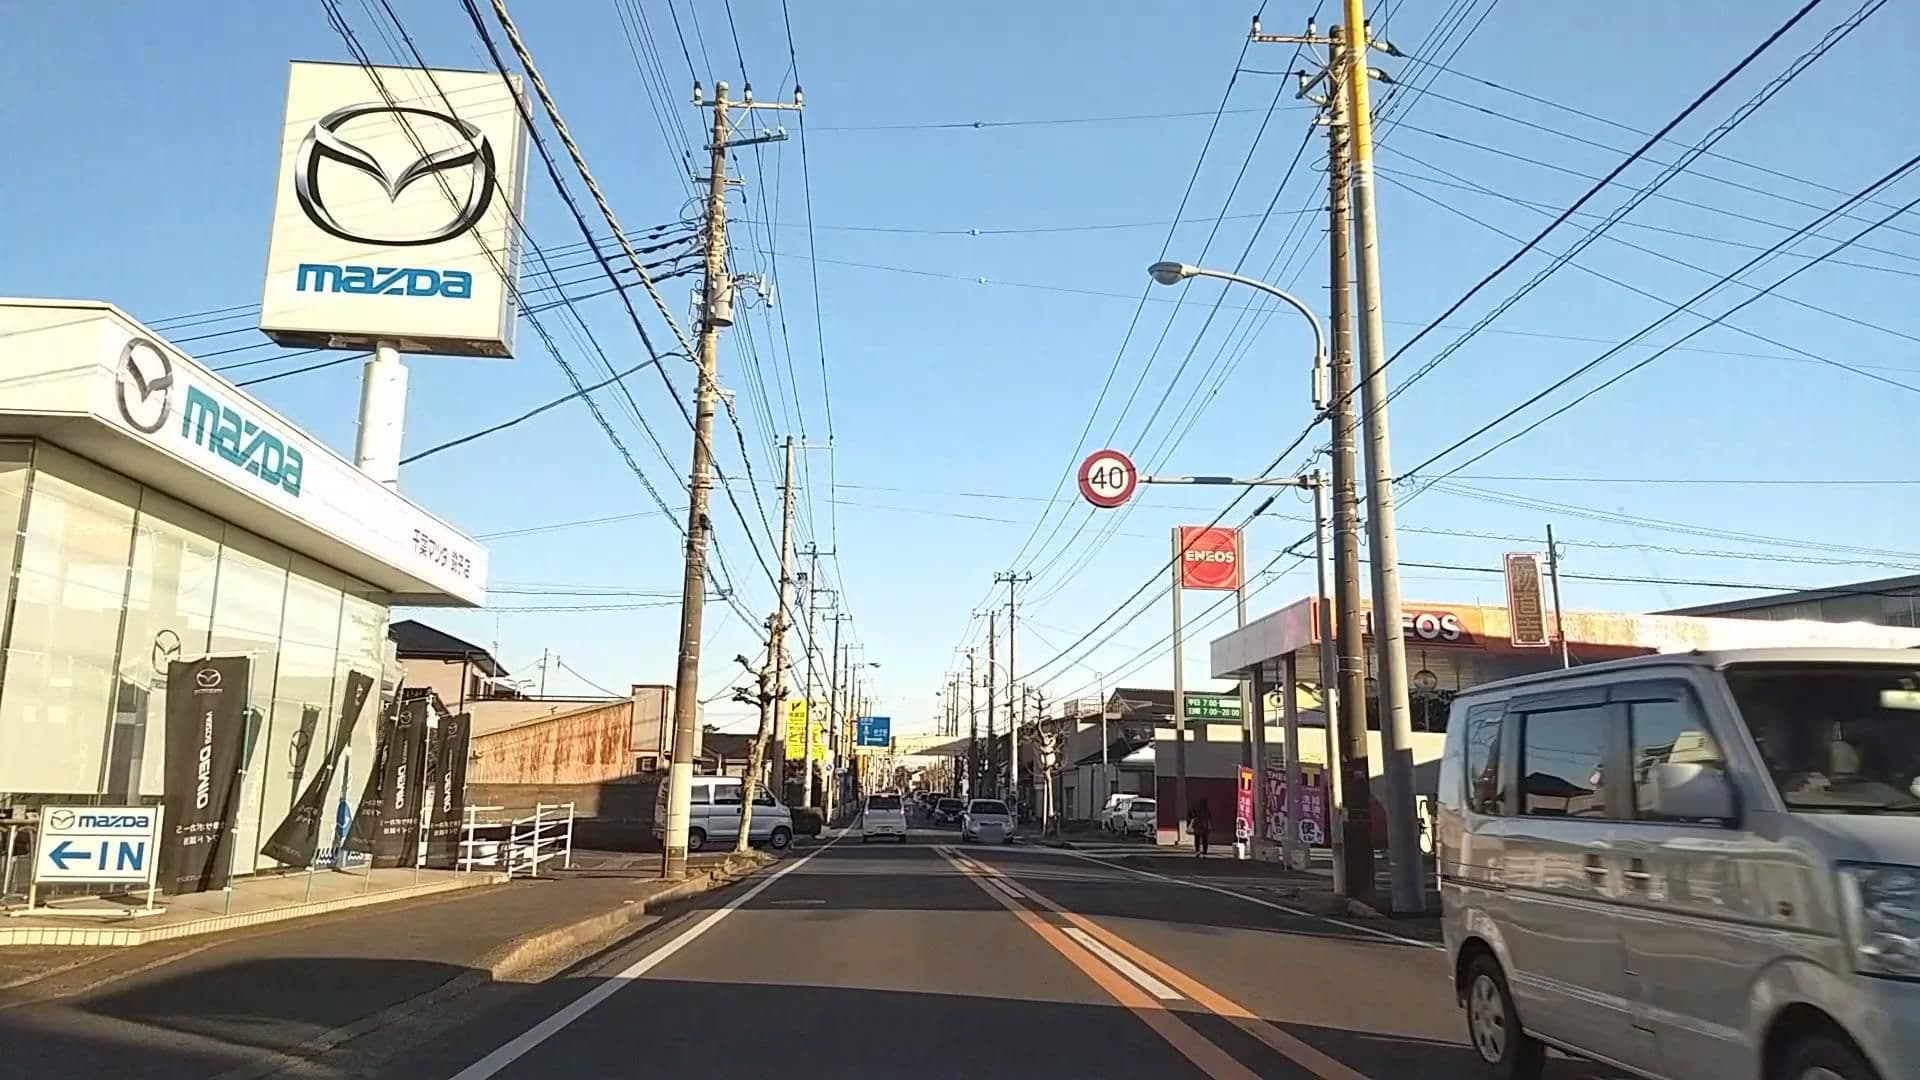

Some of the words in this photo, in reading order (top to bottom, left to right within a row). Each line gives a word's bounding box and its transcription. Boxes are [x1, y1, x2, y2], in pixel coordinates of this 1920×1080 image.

[1091, 466, 1124, 490] 40
[1185, 550, 1235, 563] ENEOS
[98, 841, 145, 871] IN
